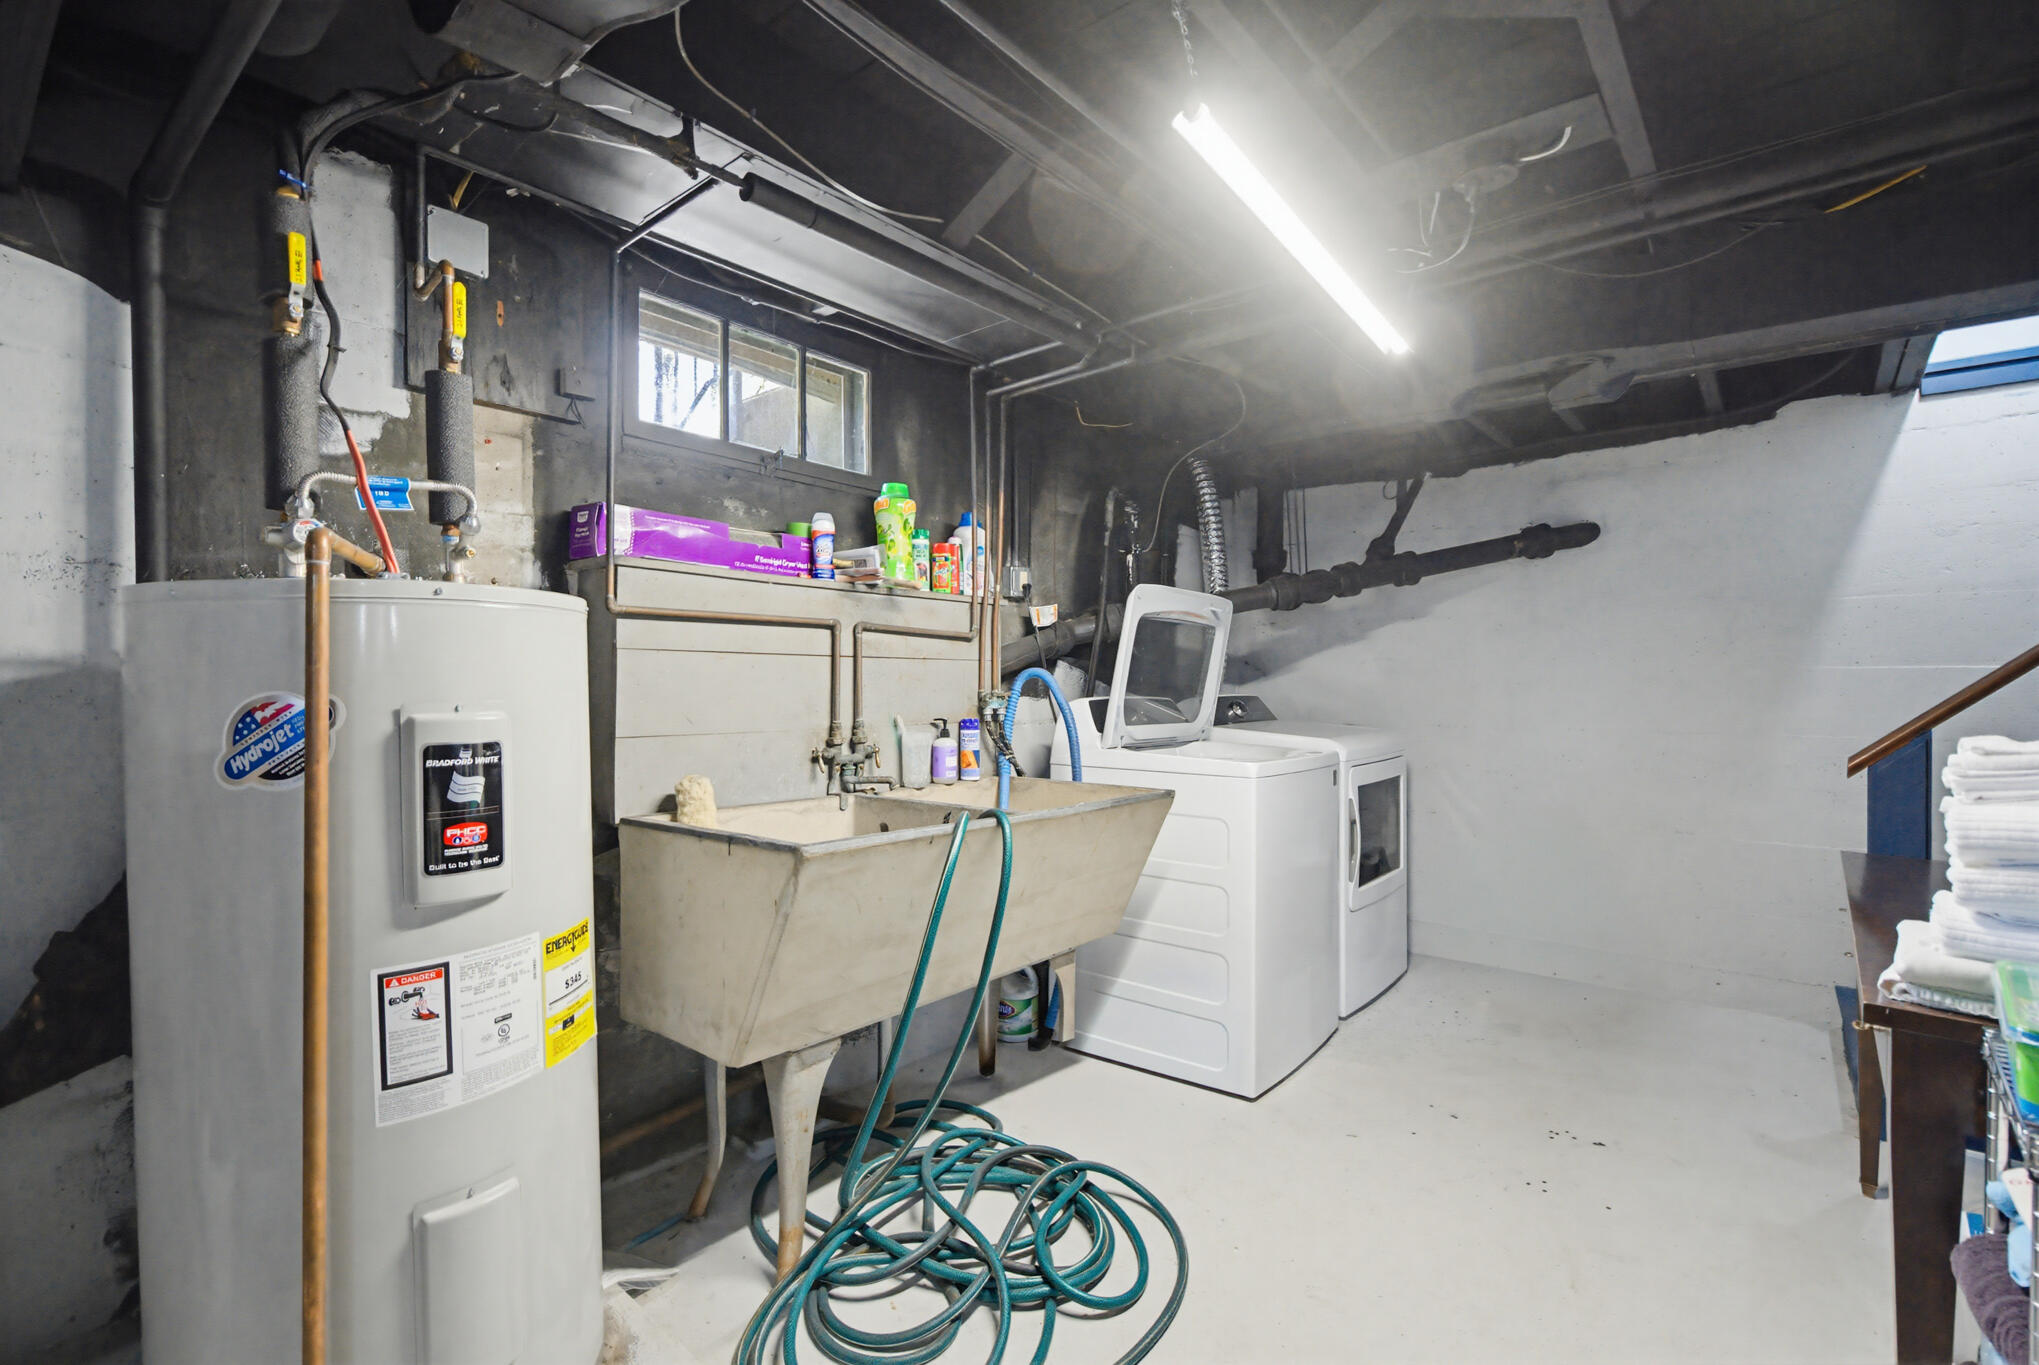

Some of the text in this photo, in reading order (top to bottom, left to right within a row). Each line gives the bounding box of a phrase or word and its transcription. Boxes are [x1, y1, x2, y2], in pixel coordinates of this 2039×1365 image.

[229, 723, 295, 774] Hydrojet
[425, 755, 500, 768] BRADFORD WHITE
[446, 825, 487, 838] PHCC
[428, 863, 447, 871] Built
[448, 861, 457, 869] to
[458, 859, 469, 868] be
[470, 857, 482, 866] the
[401, 971, 437, 984] DANGER
[564, 972, 582, 989] $345
